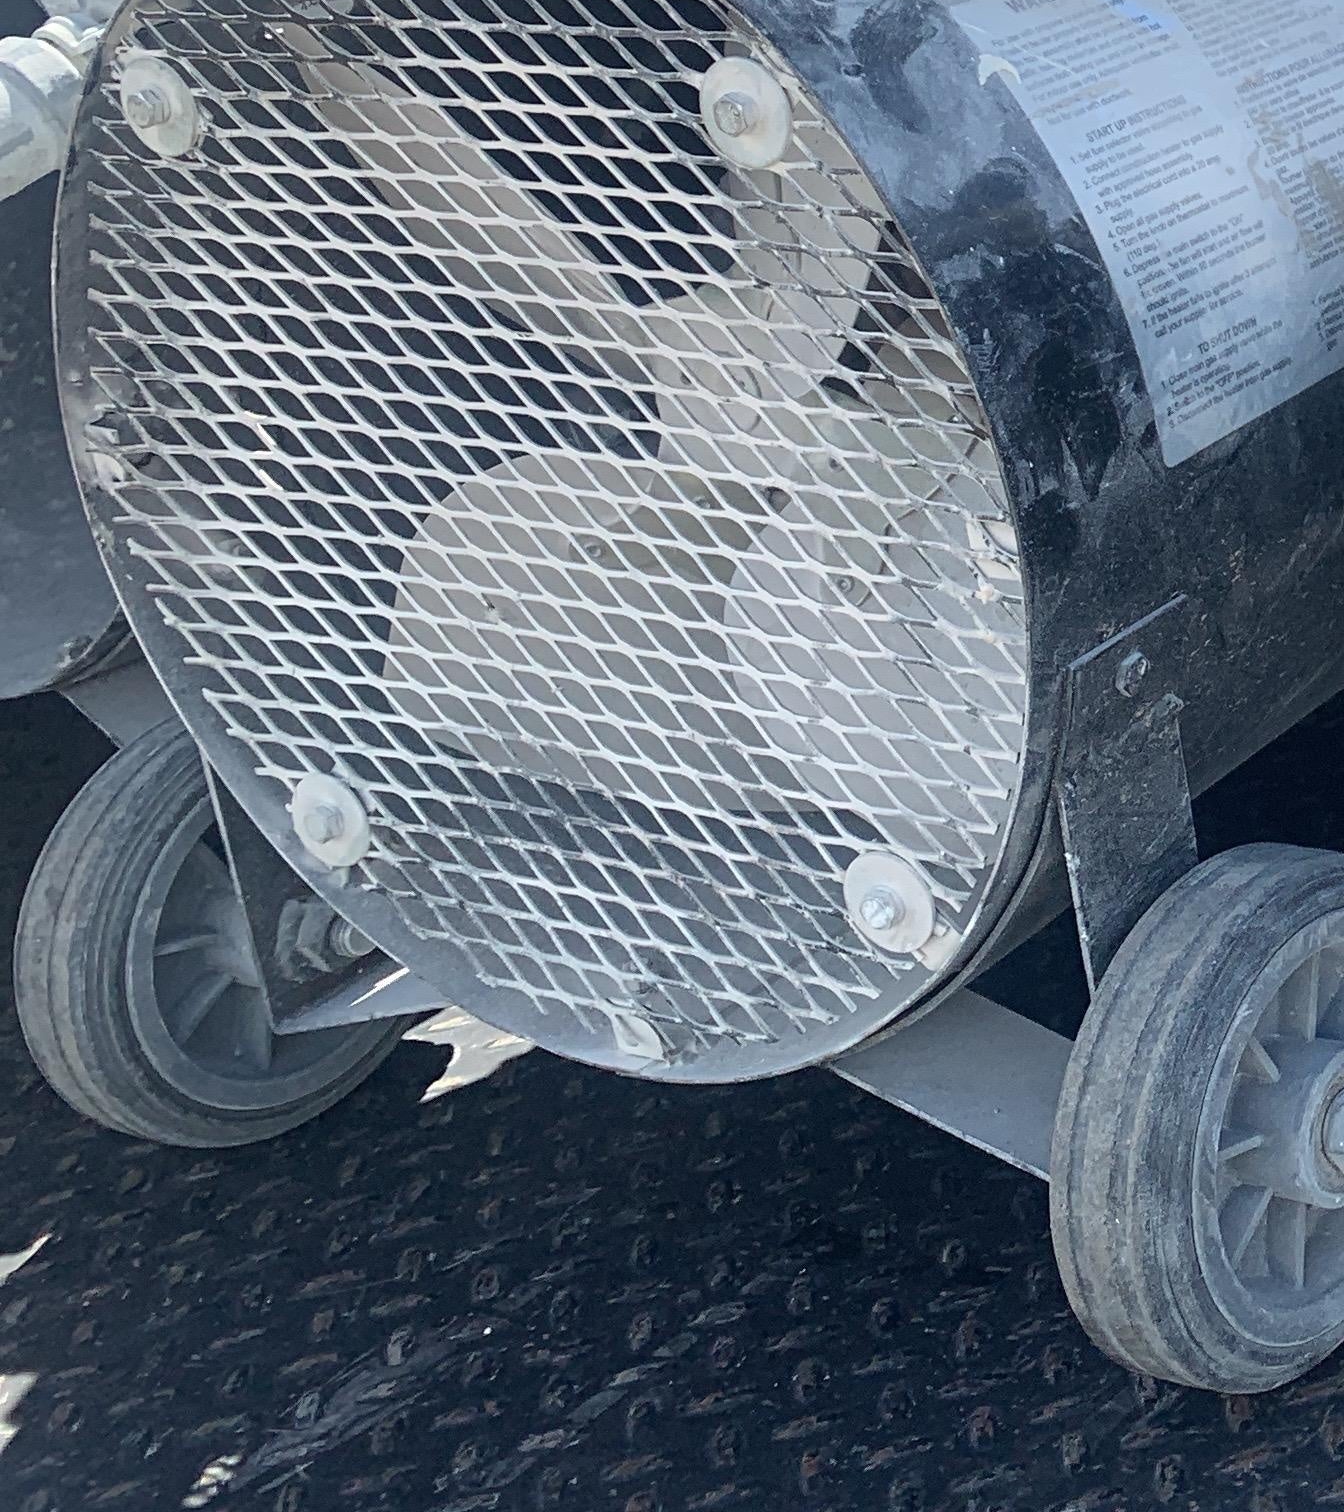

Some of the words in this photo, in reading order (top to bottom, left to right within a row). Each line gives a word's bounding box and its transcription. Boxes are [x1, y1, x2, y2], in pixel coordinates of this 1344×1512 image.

[1086, 123, 1114, 142] START
[1114, 118, 1127, 130] UP
[1126, 93, 1186, 125] INSTRUCTIONS
[1078, 150, 1091, 161] Set
[1085, 157, 1108, 174] supply
[1091, 166, 1119, 184] Connect
[1097, 185, 1112, 197] with
[1113, 171, 1145, 191] approved
[1103, 197, 1120, 210] Plug
[1120, 191, 1132, 202] the
[1132, 178, 1162, 197] electrical
[1115, 221, 1135, 236] Open
[1144, 211, 1157, 223] gas
[1158, 200, 1180, 216] supply
[1121, 234, 1138, 247] Turn
[1137, 229, 1149, 239] the
[1149, 222, 1166, 234] knob
[1176, 202, 1210, 221] thermostat
[1131, 255, 1160, 274] Depress
[1176, 266, 1198, 281] Within
[1146, 296, 1169, 312] should
[1156, 310, 1168, 321] the
[1167, 299, 1190, 316] heater
[1167, 319, 1183, 333] your
[1197, 340, 1211, 353] TO
[1209, 328, 1233, 347] SHUT
[1231, 316, 1258, 336] DOWN
[1168, 369, 1188, 385] Close
[1188, 361, 1205, 374] main
[1204, 355, 1218, 367] gas
[1217, 343, 1239, 360] supply
